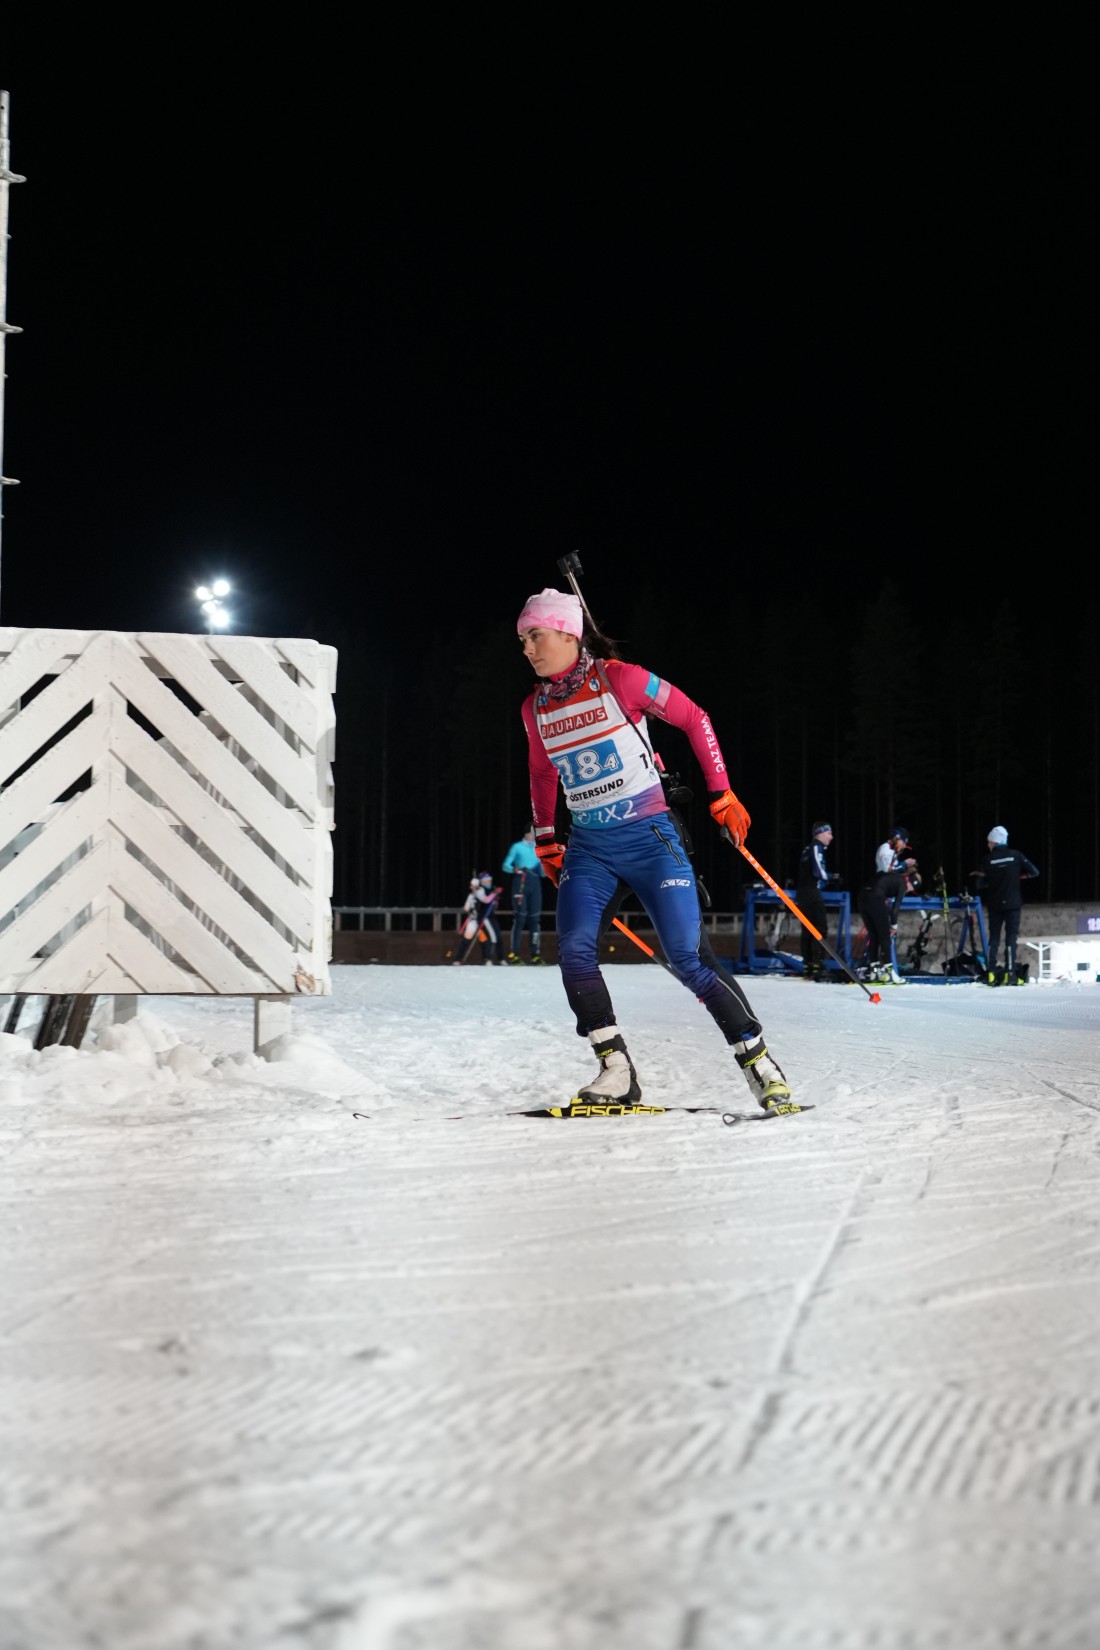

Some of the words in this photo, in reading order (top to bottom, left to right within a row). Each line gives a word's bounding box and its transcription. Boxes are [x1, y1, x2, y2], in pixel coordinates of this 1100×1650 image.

[541, 707, 606, 738] BAUHAUS
[701, 715, 716, 749] TEAM
[710, 748, 726, 772] QAZ
[569, 778, 624, 802] ÖSTERSUND
[571, 1105, 666, 1117] FISCHER
